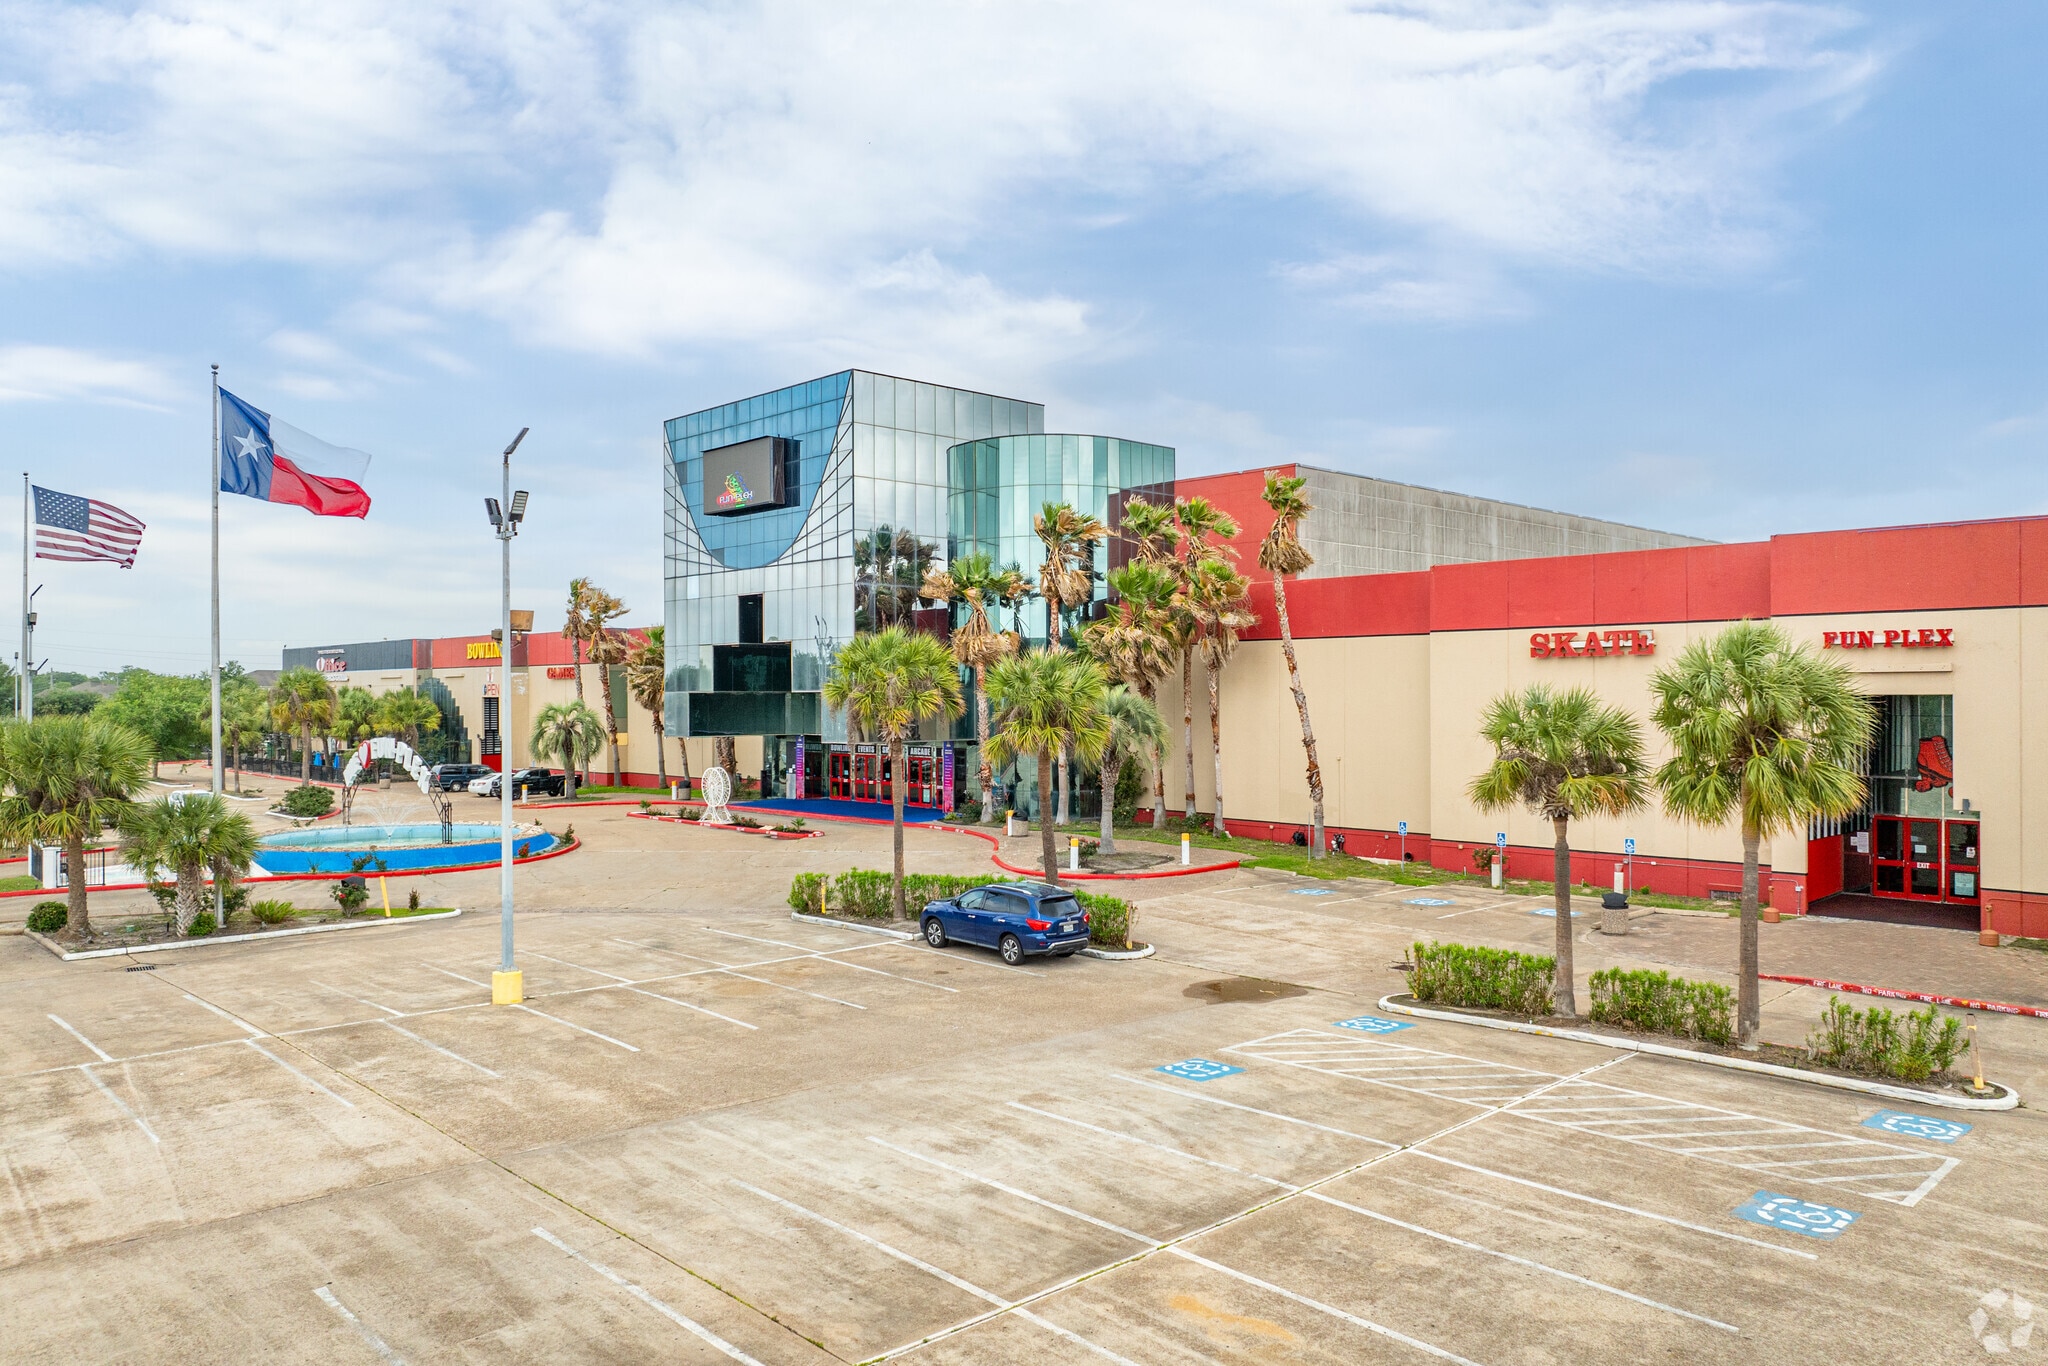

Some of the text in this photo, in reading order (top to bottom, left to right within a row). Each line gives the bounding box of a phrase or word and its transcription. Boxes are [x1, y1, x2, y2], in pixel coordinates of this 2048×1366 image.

[1530, 630, 1655, 659] SKATE
[1822, 628, 1954, 650] FUN PLEX
[466, 642, 502, 659] BOWLIN
[910, 747, 931, 756] ARCADE
